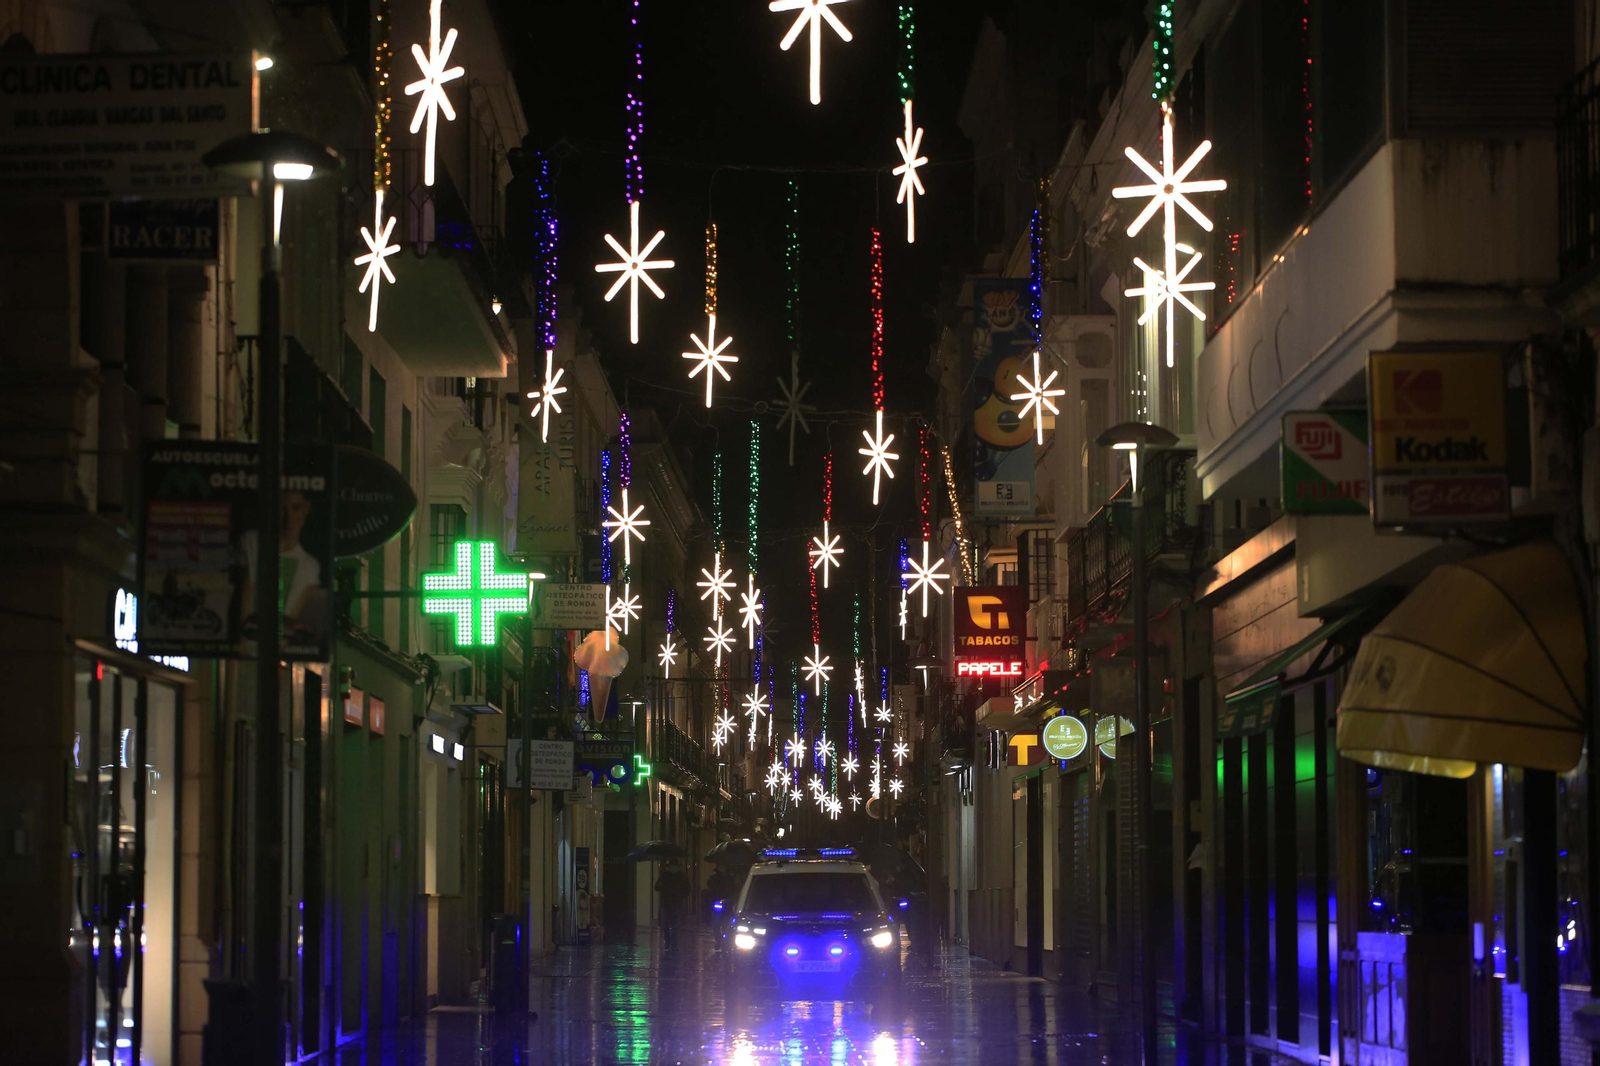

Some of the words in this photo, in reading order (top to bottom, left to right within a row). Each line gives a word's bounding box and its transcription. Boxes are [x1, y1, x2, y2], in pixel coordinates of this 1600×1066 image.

[1, 64, 112, 94] CLINICA
[130, 61, 240, 90] DENTAL
[104, 106, 153, 124] VARGAS
[113, 224, 212, 249] RACER
[1295, 422, 1338, 455] FUJI
[1395, 436, 1488, 463] Kodak
[959, 635, 1019, 646] TABACOS
[958, 662, 1022, 676] PAPELE
